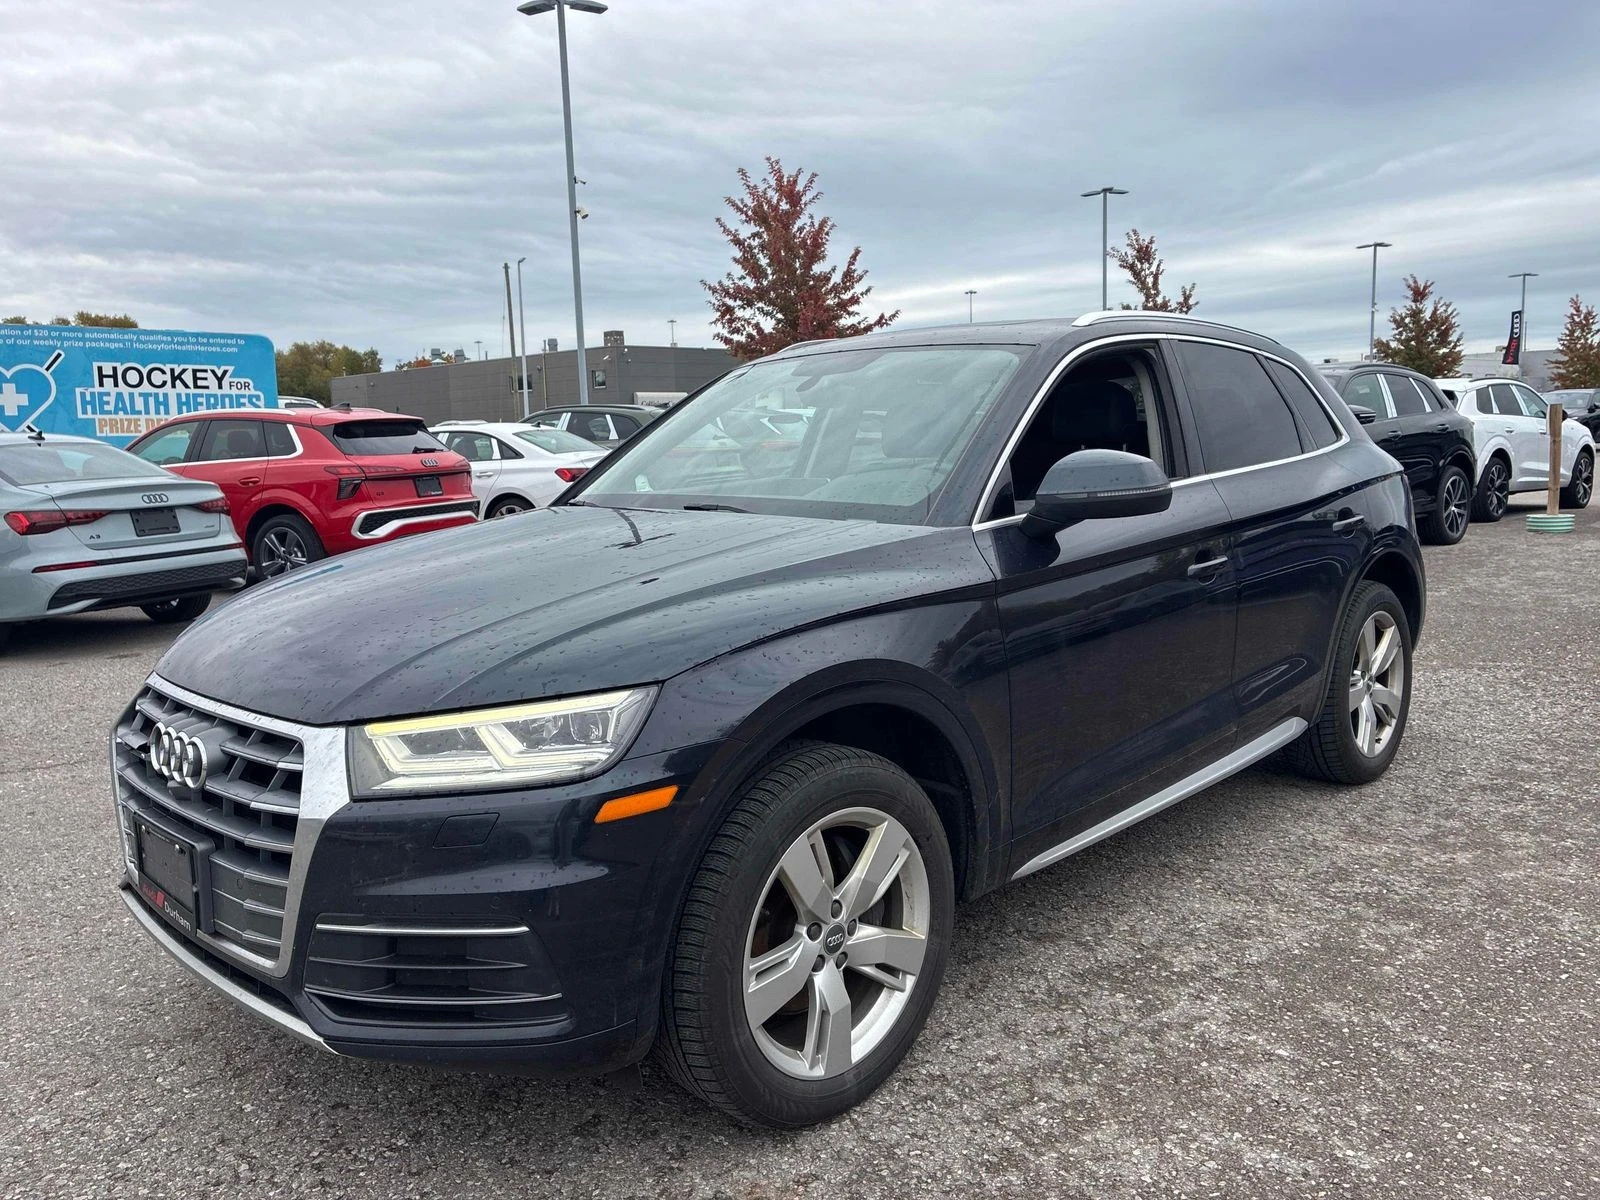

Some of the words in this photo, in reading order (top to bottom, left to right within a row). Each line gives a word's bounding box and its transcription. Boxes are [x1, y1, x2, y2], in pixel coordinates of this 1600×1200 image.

[33, 338, 61, 347] weekly
[64, 340, 84, 348] prize
[34, 329, 48, 337] $20
[84, 331, 137, 341] automatically
[139, 333, 171, 342] qualifies
[209, 337, 236, 345] entered
[97, 366, 229, 389] HOCKEY
[229, 381, 251, 391] FOR
[79, 391, 170, 415] HEALTH
[176, 393, 261, 414] HEROES
[98, 417, 142, 434] PRIZE
[164, 900, 191, 931] Durham
